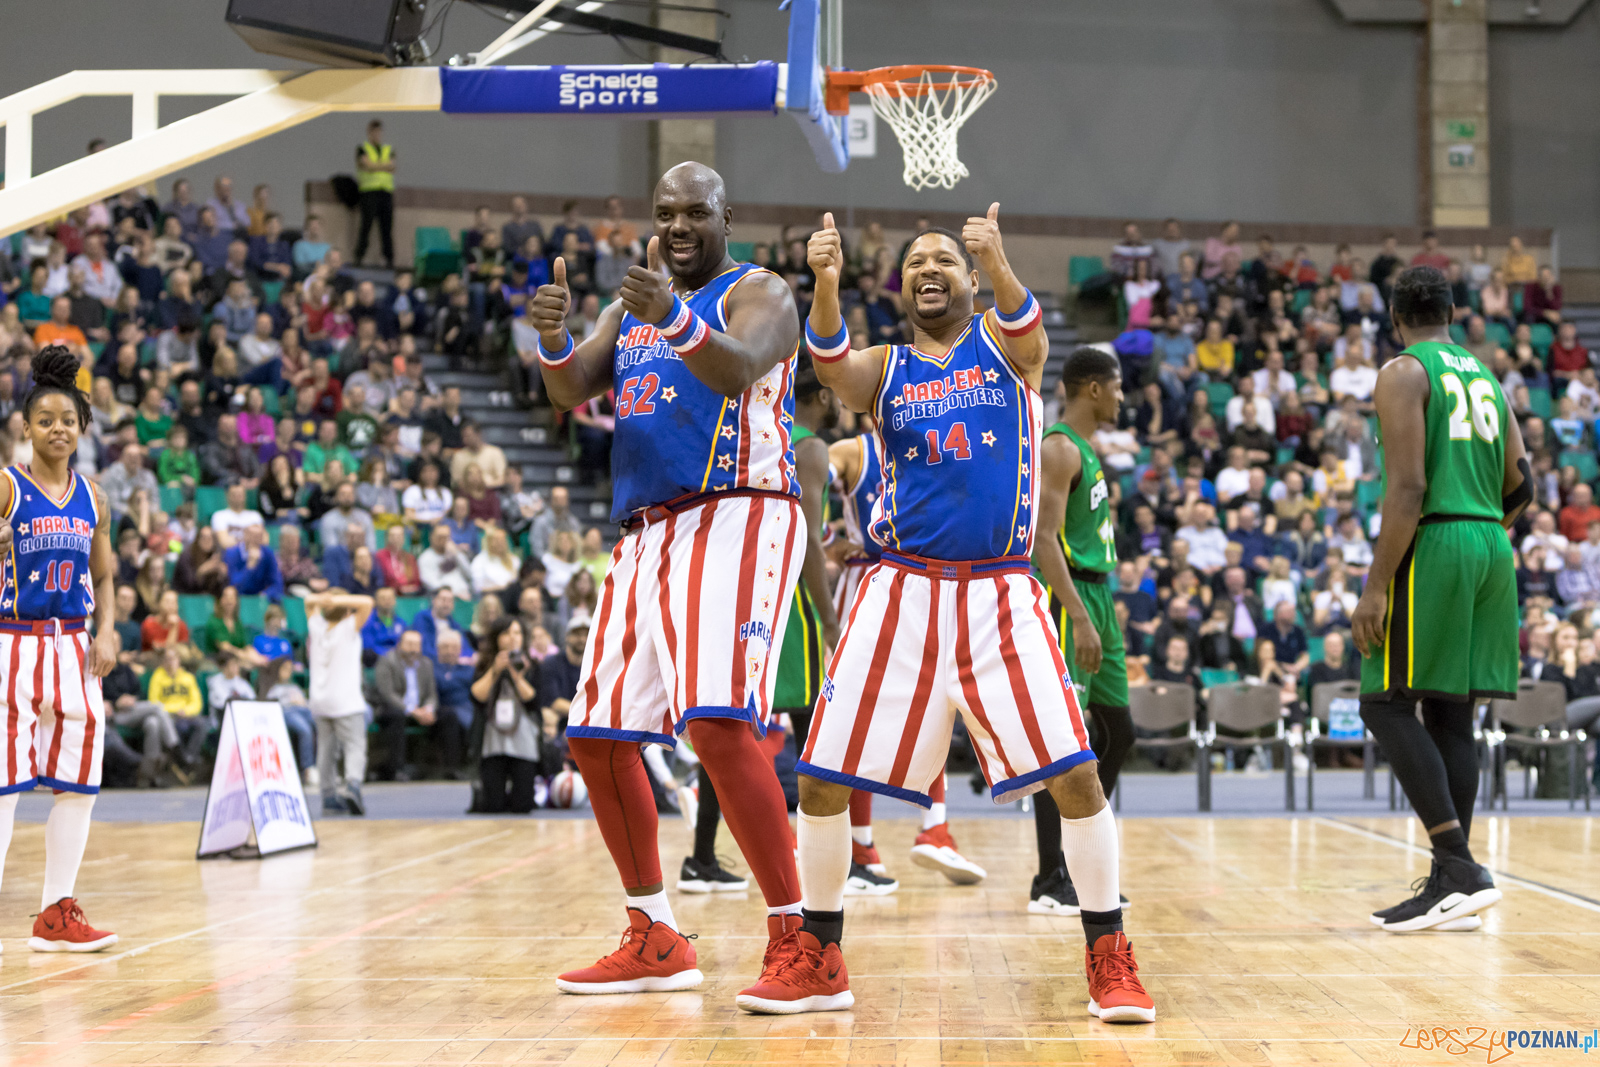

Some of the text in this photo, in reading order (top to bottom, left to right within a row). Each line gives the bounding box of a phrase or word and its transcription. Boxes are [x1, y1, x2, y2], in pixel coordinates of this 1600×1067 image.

[560, 73, 658, 89] Schelde
[560, 88, 658, 109] Sports
[619, 372, 660, 420] 52
[903, 365, 984, 404] HARLEM
[1440, 372, 1499, 444] 26
[925, 422, 972, 465] 14
[31, 516, 90, 539] HARLEM
[44, 560, 74, 593] 10
